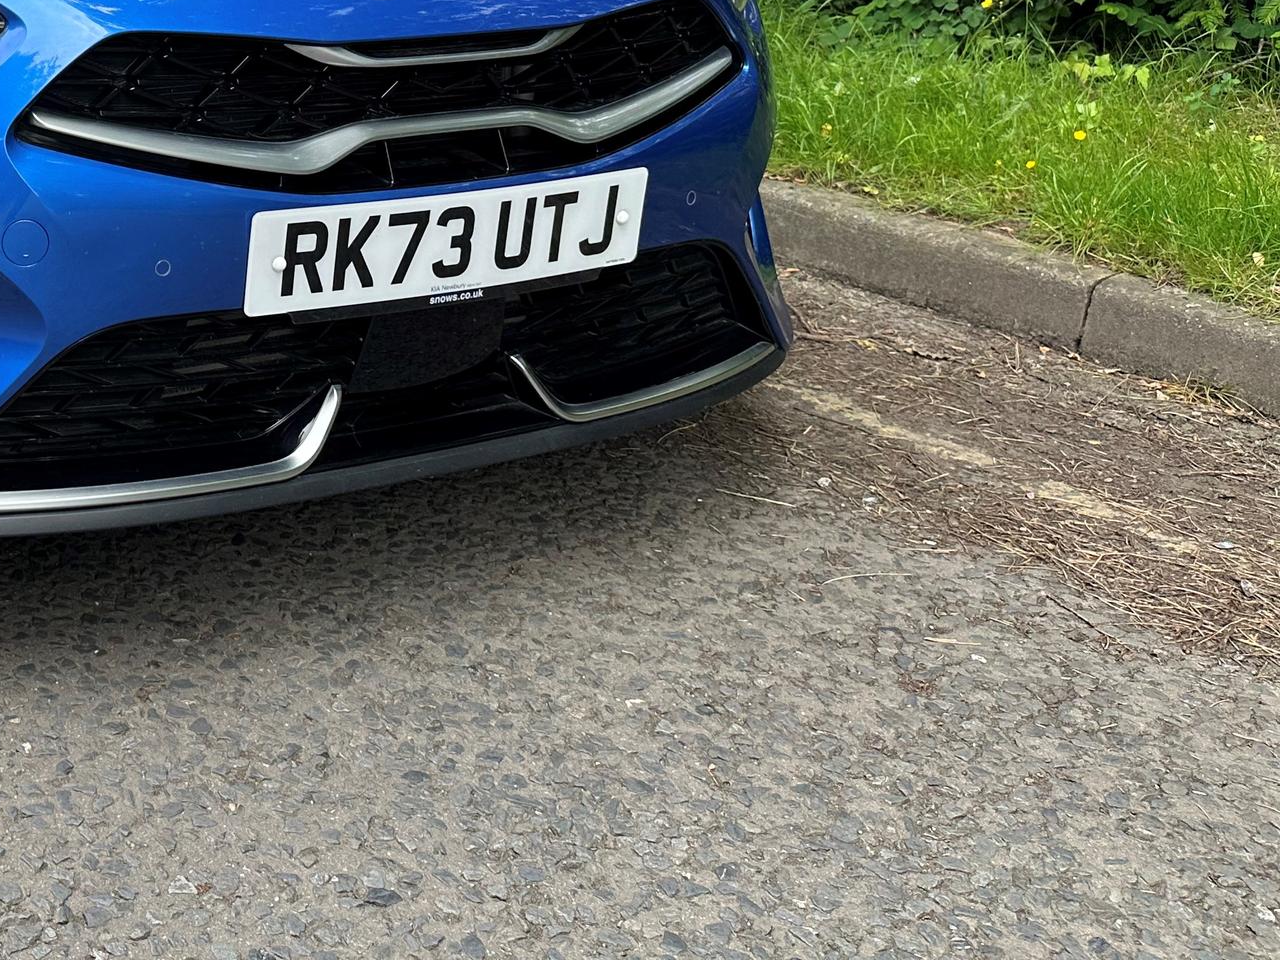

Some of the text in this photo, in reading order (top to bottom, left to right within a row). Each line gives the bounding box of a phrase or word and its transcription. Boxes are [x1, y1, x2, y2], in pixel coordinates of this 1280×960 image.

[280, 184, 620, 297] RK73 UTJ
[442, 282, 466, 291] Newbury
[429, 289, 484, 305] snows.co.uk
